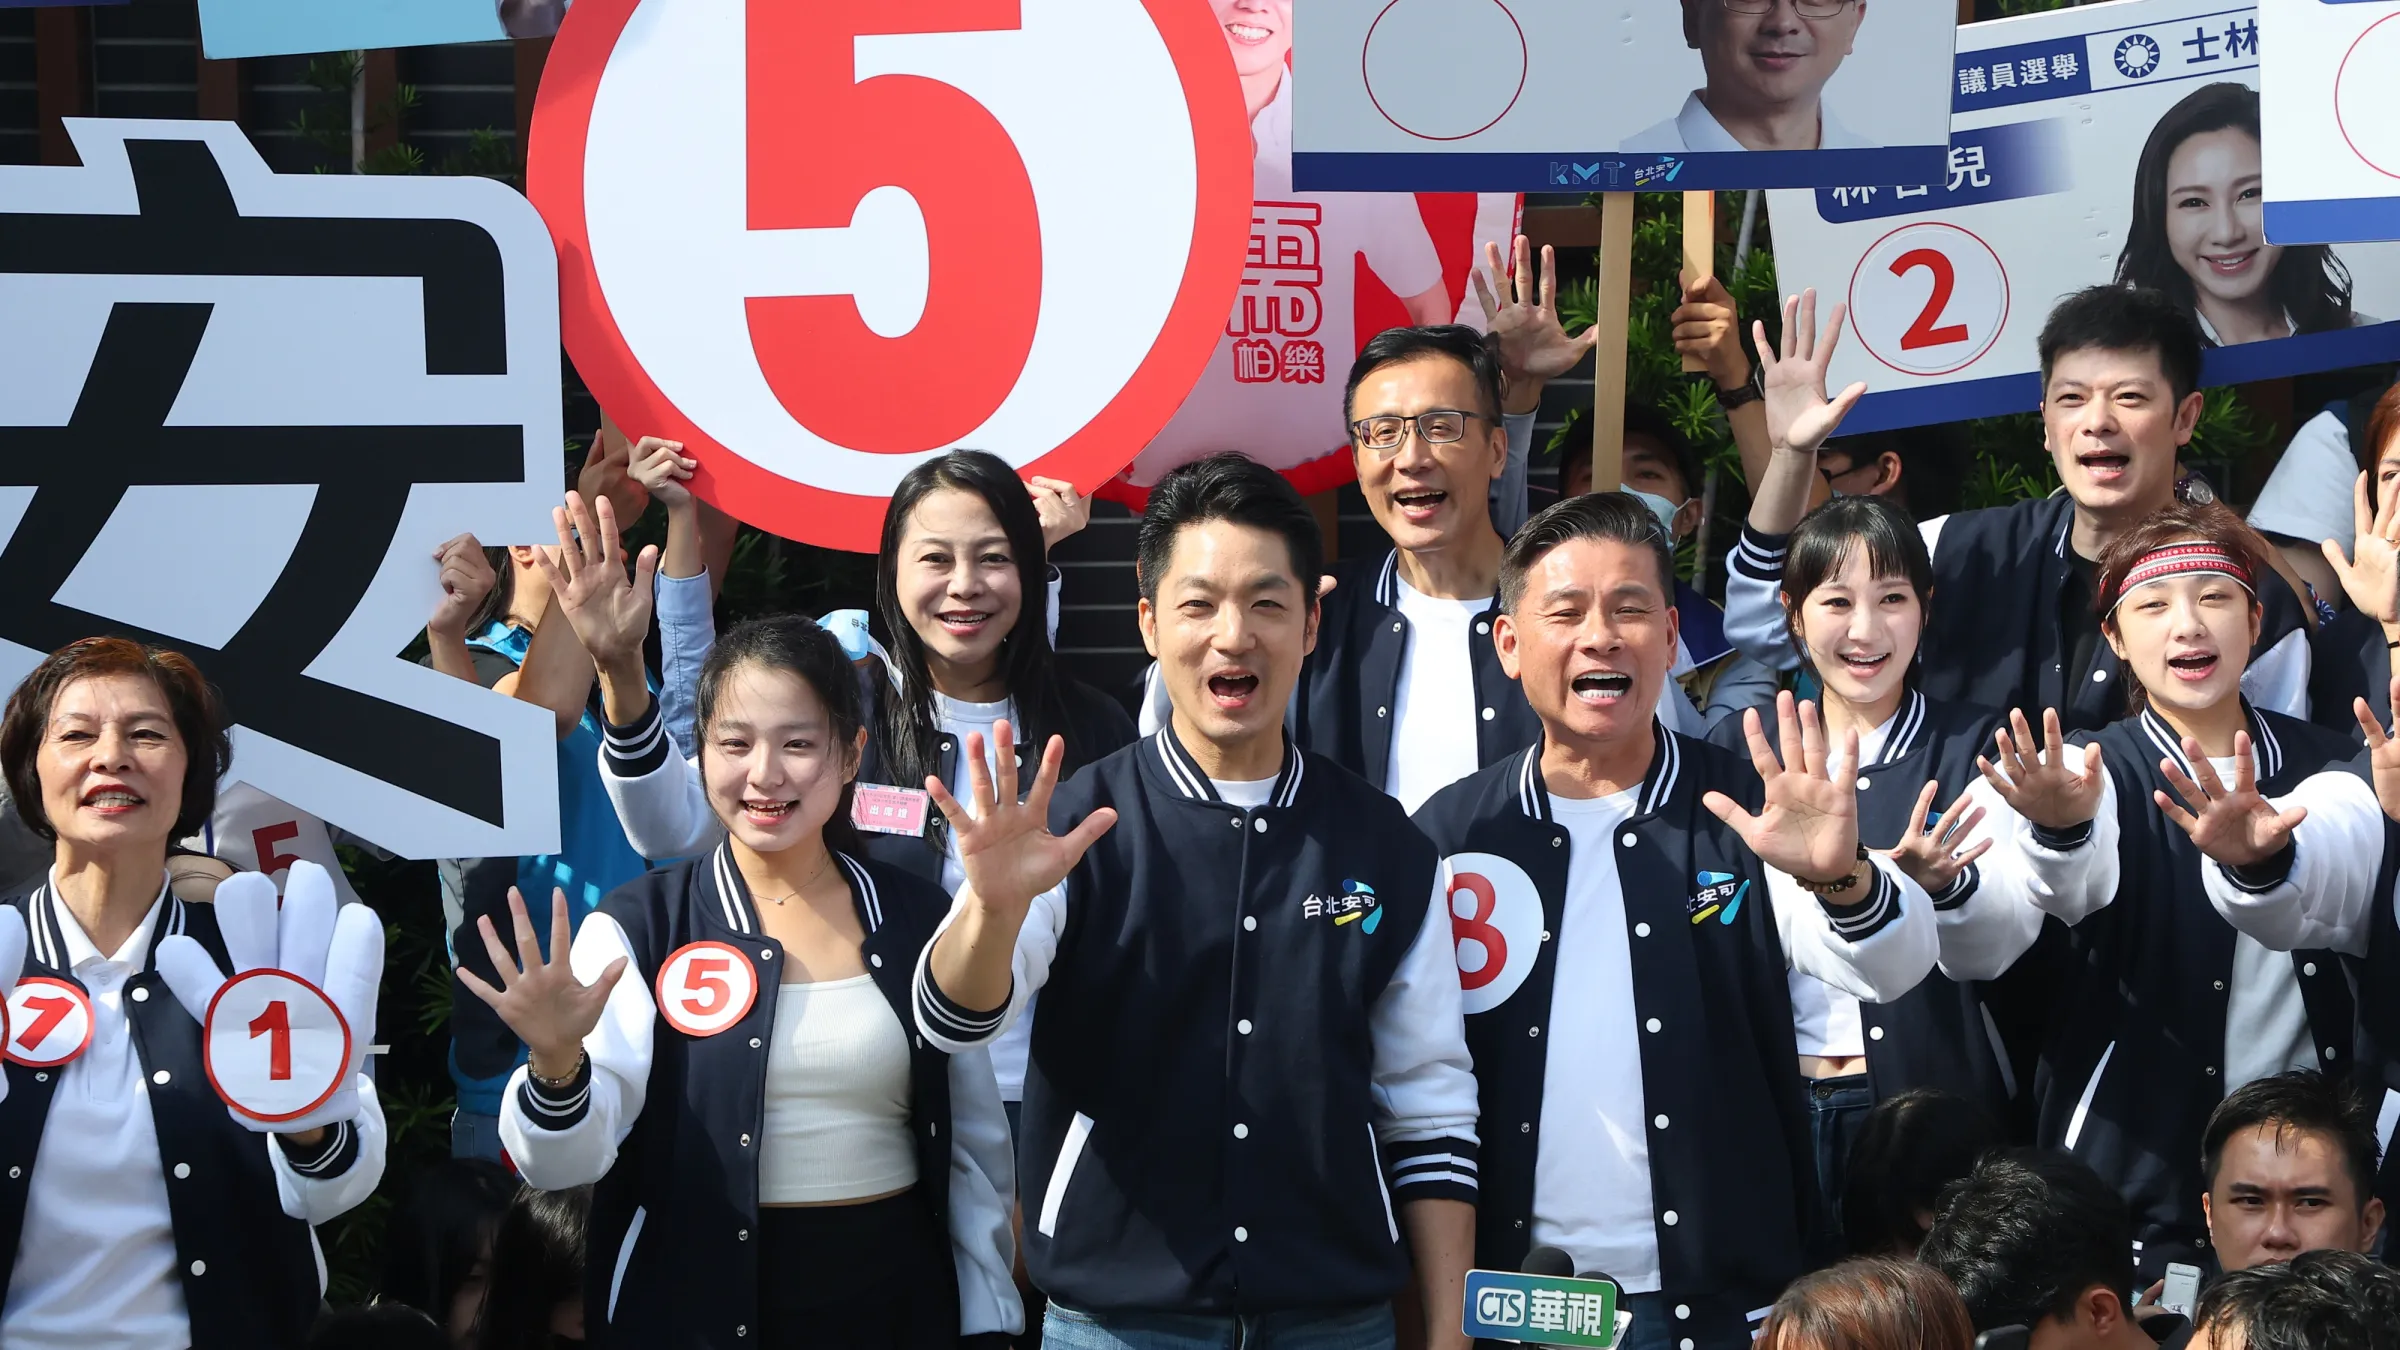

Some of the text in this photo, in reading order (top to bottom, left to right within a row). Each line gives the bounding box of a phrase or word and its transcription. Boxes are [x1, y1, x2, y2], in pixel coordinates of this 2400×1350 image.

[2182, 18, 2259, 64] 士林
[1957, 53, 2079, 95] 議員選舉
[1550, 162, 1626, 185] KMT
[1634, 162, 1675, 180] 台北安可
[743, 0, 1043, 455] 5
[1888, 248, 1969, 351] 2
[1234, 340, 1323, 383] 柏樂
[0, 139, 525, 829] 安
[1302, 893, 1376, 920] 台北安可
[1447, 872, 1508, 991] 8
[681, 958, 731, 1016] 5
[248, 1001, 291, 1080] 1
[1479, 1288, 1602, 1337] CTS 華視
